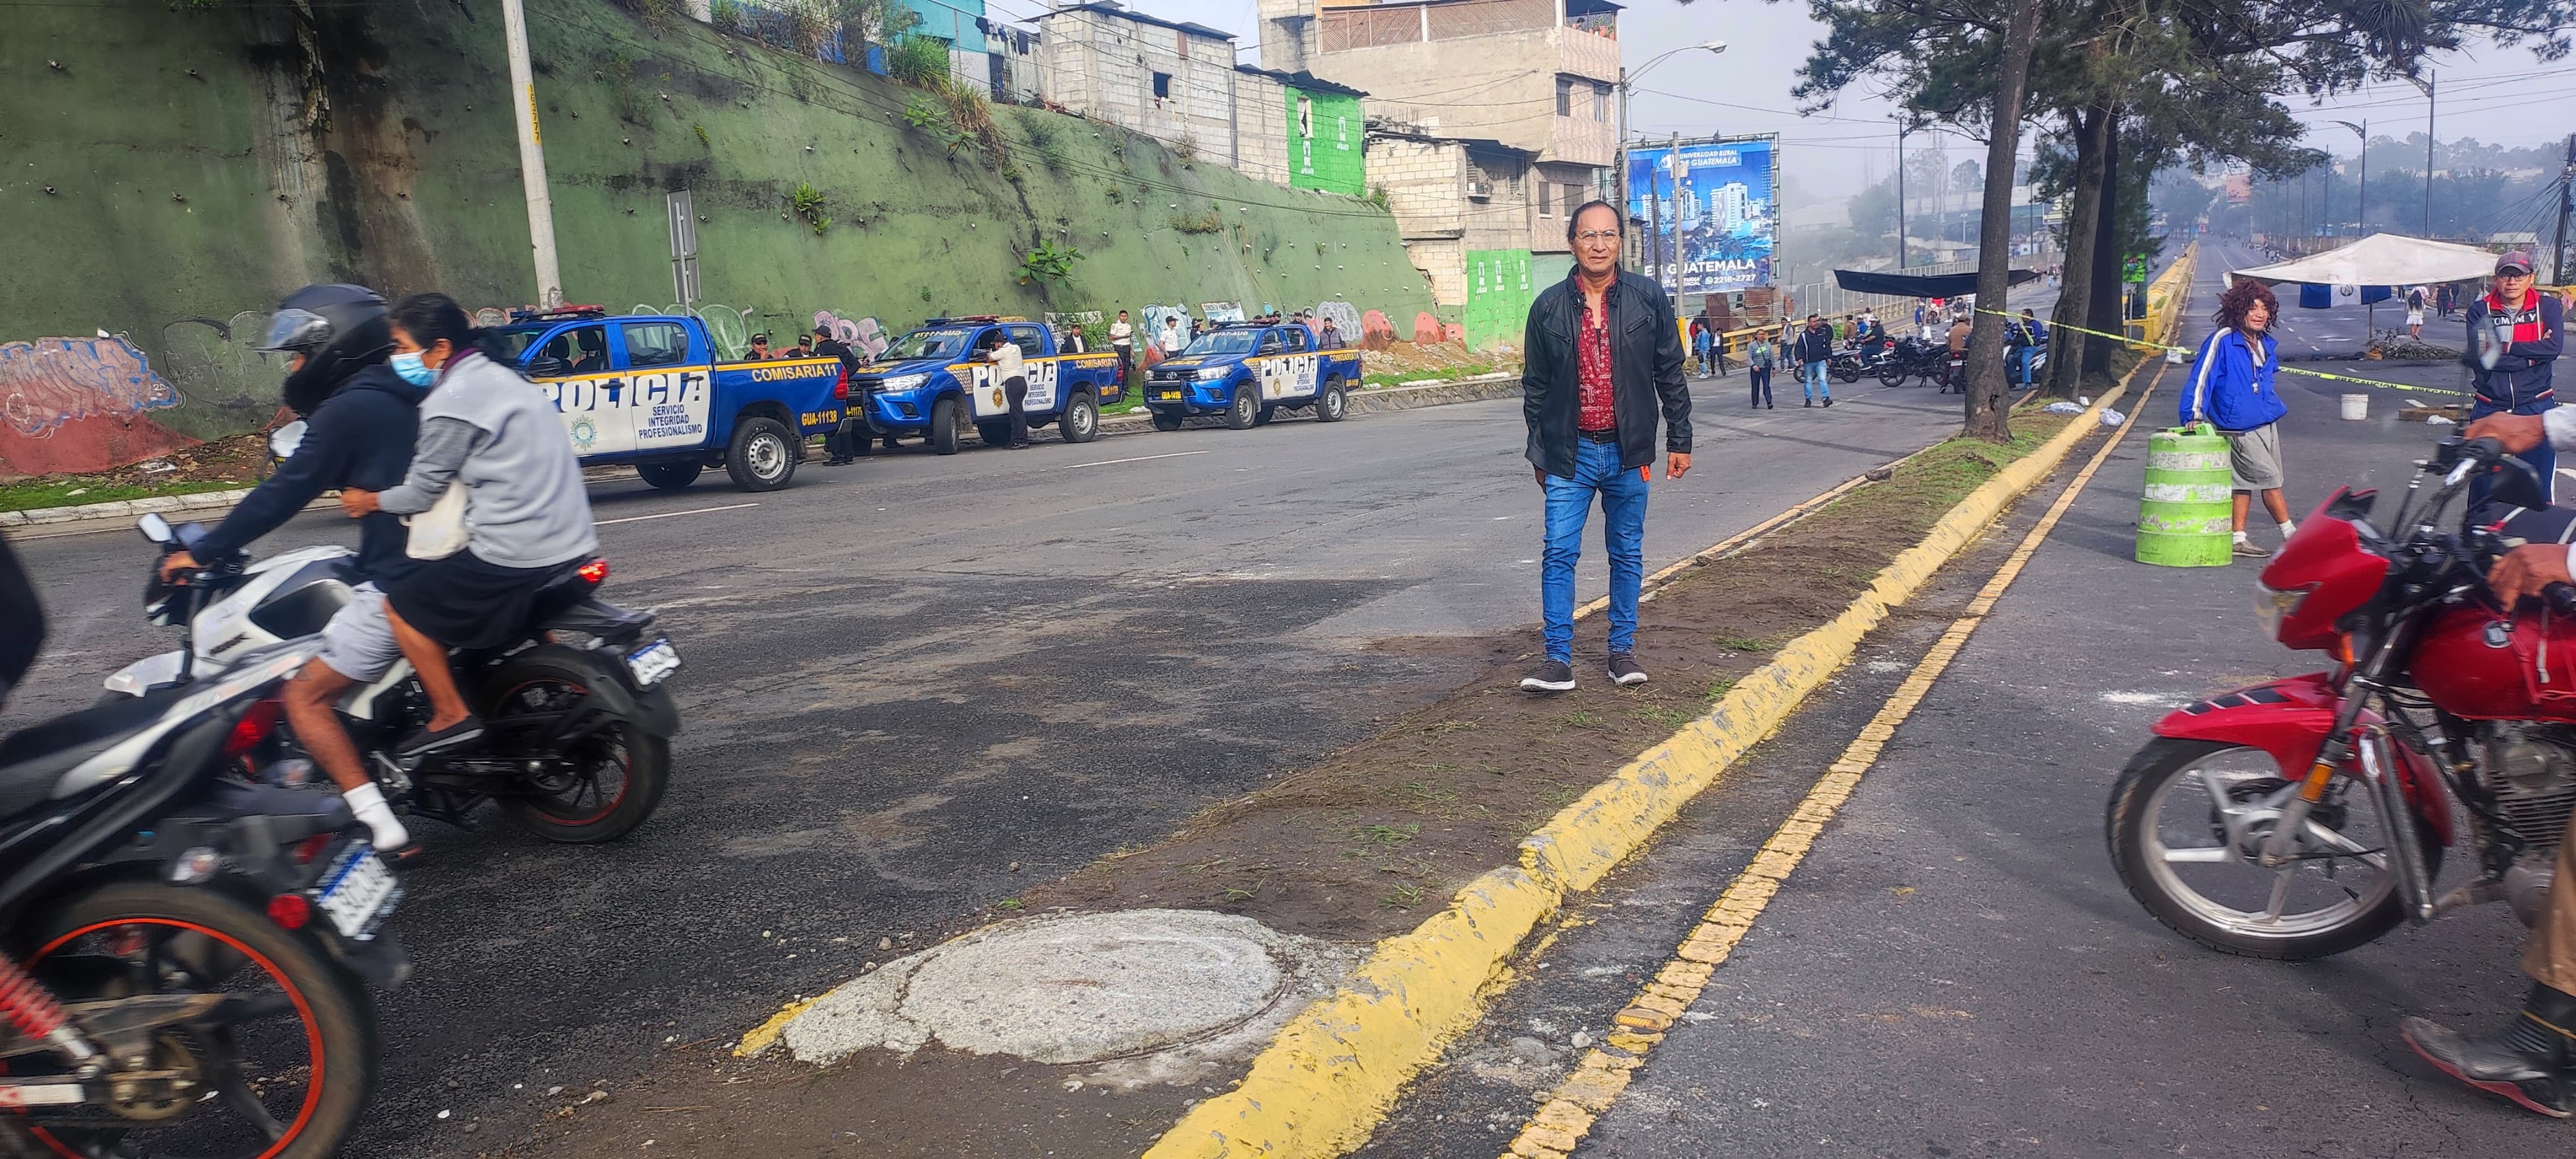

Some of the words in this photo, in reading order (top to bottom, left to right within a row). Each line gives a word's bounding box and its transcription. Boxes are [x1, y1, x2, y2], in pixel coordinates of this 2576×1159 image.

[1679, 151, 1718, 159] UNIVERSIDAD
[1691, 157, 1737, 167] GUATEMALA
[1713, 274, 1756, 284] 2218-2727
[974, 362, 1055, 387] POCIA
[653, 404, 685, 417] SERVICIO
[648, 414, 689, 427] INTEGRIDAD
[801, 410, 837, 427] GUA-11138
[638, 423, 703, 439] PROFESIONALISMO
